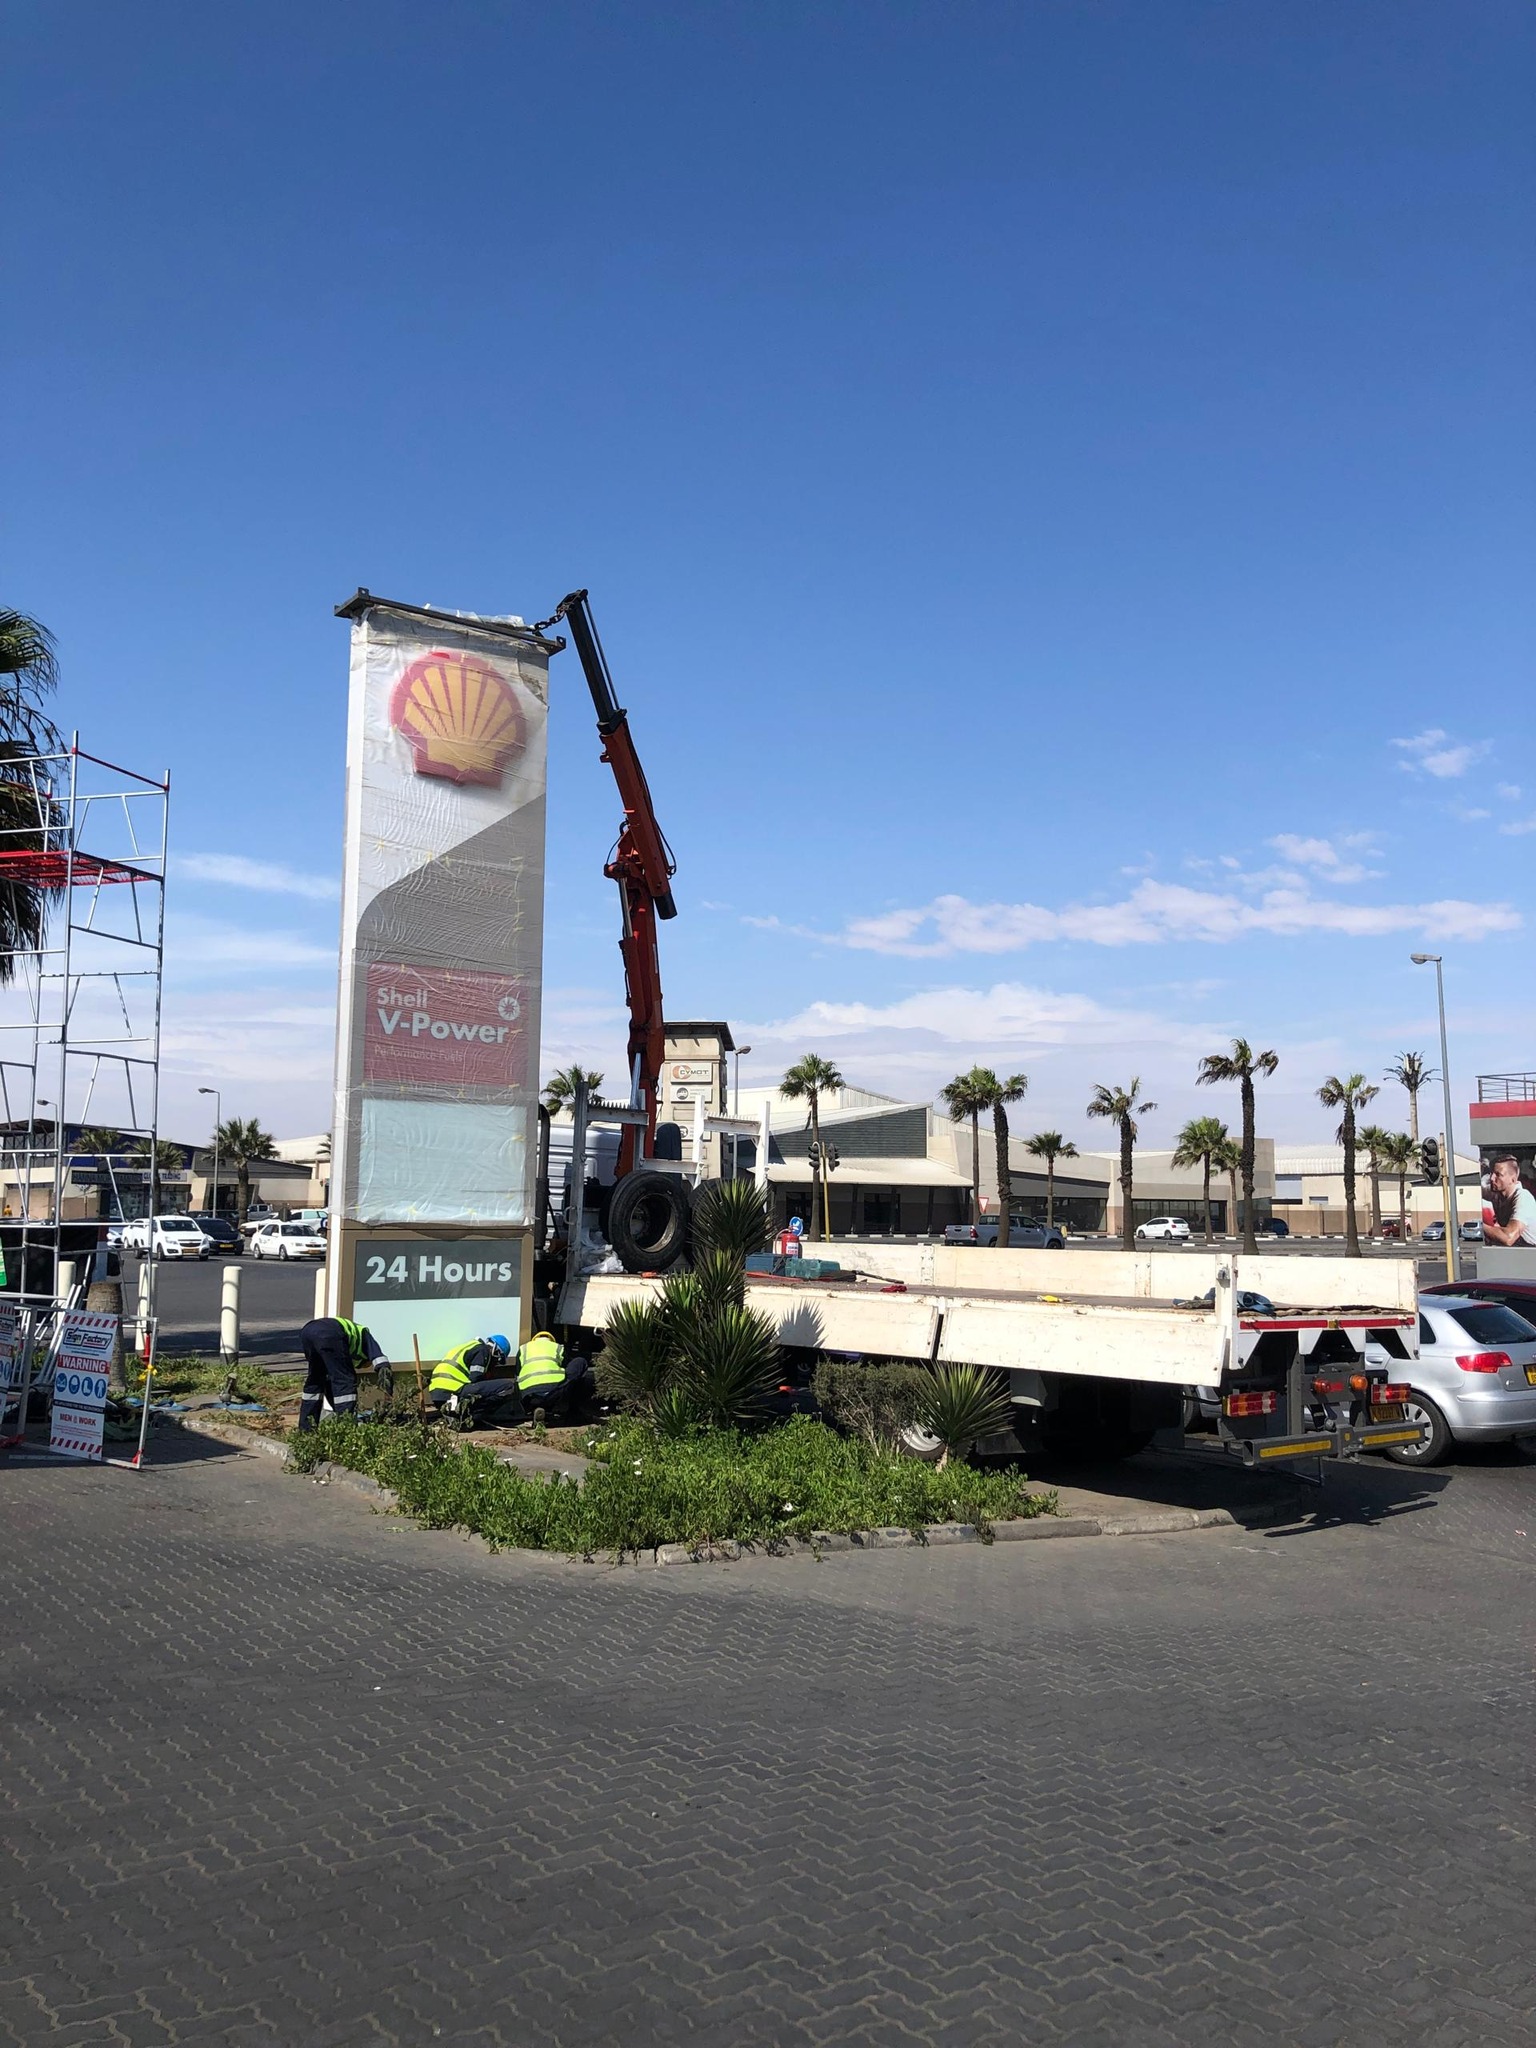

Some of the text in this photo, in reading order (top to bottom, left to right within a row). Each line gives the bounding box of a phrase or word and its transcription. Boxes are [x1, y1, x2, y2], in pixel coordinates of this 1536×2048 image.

[377, 986, 428, 1009] Shell
[377, 1007, 510, 1044] V-Power
[374, 1044, 464, 1063] Performance Fuels
[365, 1254, 513, 1284] 24 Hours
[66, 1330, 110, 1345] Sign Factory
[62, 1355, 107, 1373] WARNING
[59, 1413, 72, 1423] MEN
[78, 1416, 97, 1426] WORK
